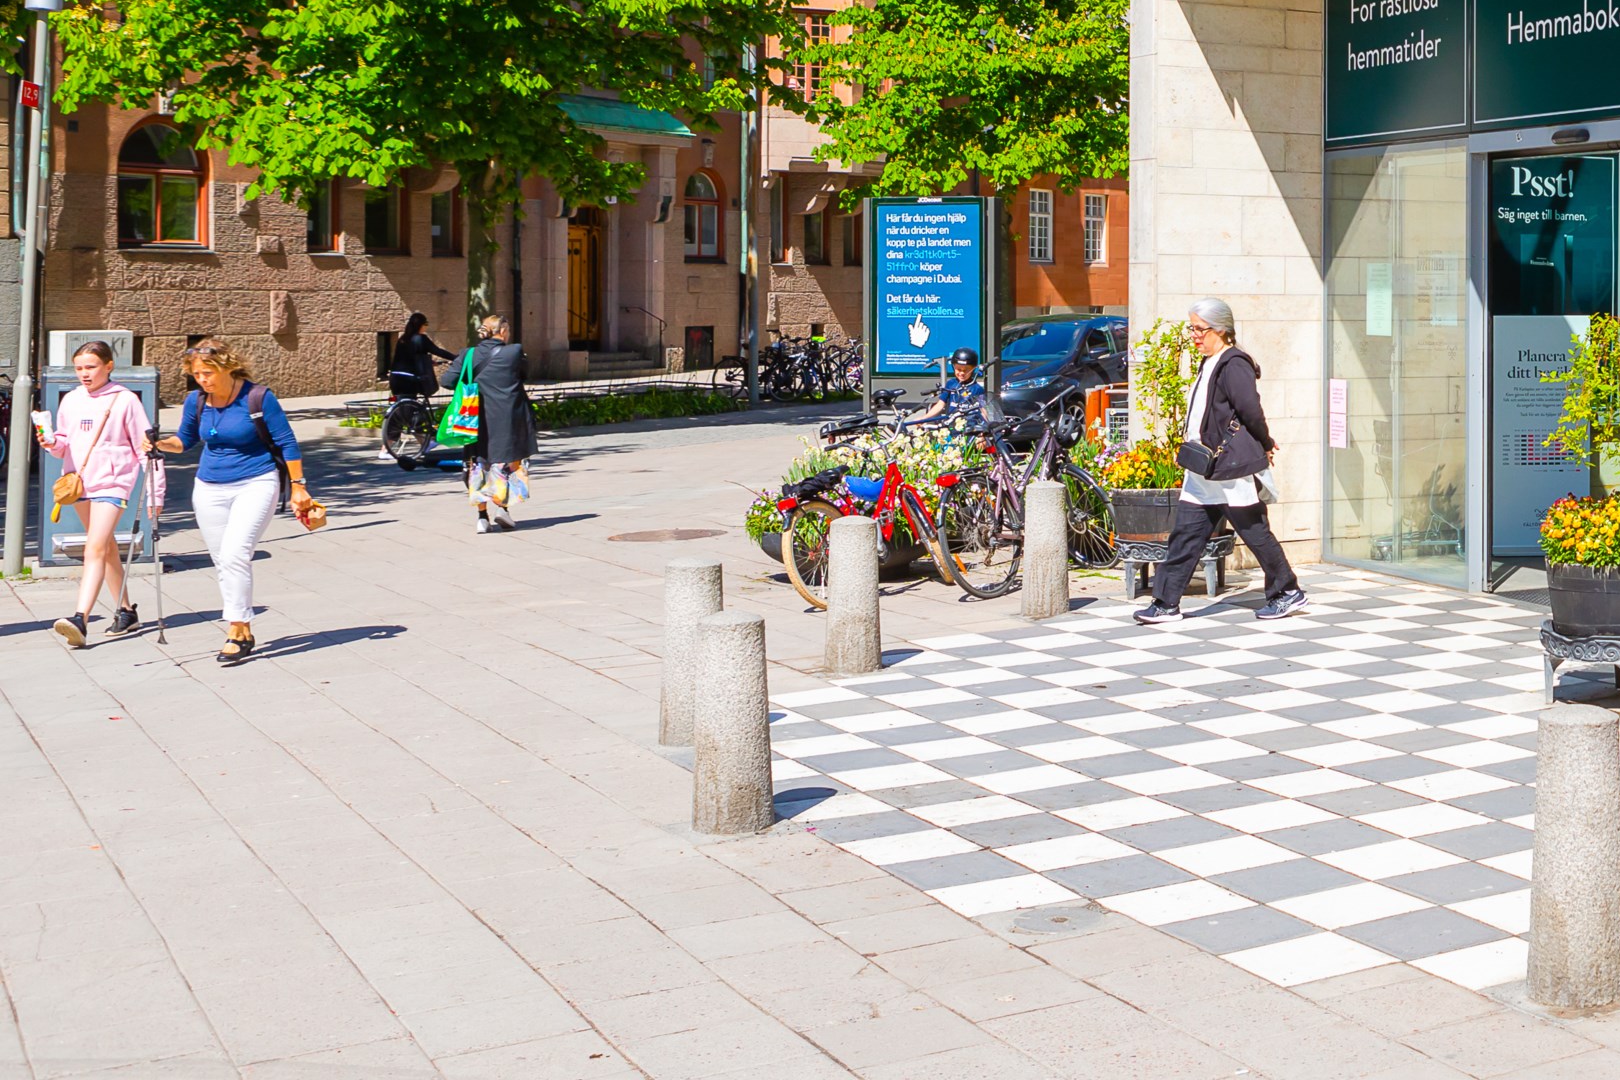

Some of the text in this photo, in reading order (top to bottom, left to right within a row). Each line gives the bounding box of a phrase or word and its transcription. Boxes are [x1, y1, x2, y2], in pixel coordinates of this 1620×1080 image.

[1347, 30, 1442, 72] hemmatider
[23, 86, 38, 101] 12,9
[1511, 166, 1574, 198] Psst!
[886, 213, 966, 224] Här får du ingen hjälp
[1498, 206, 1587, 223] Säg inget till barnen.
[886, 226, 900, 234] när
[900, 226, 910, 234] du
[911, 226, 938, 234] dricker
[886, 238, 971, 248] kopp te på landet men
[886, 250, 903, 259] dina
[920, 262, 943, 272] köper
[886, 274, 932, 284] champagne
[937, 274, 962, 283] Dubai.
[886, 294, 941, 303] Det får du här:
[886, 306, 964, 315] säkerhetskollen.se
[1518, 348, 1567, 362] Planera
[1507, 366, 1531, 379] ditt
